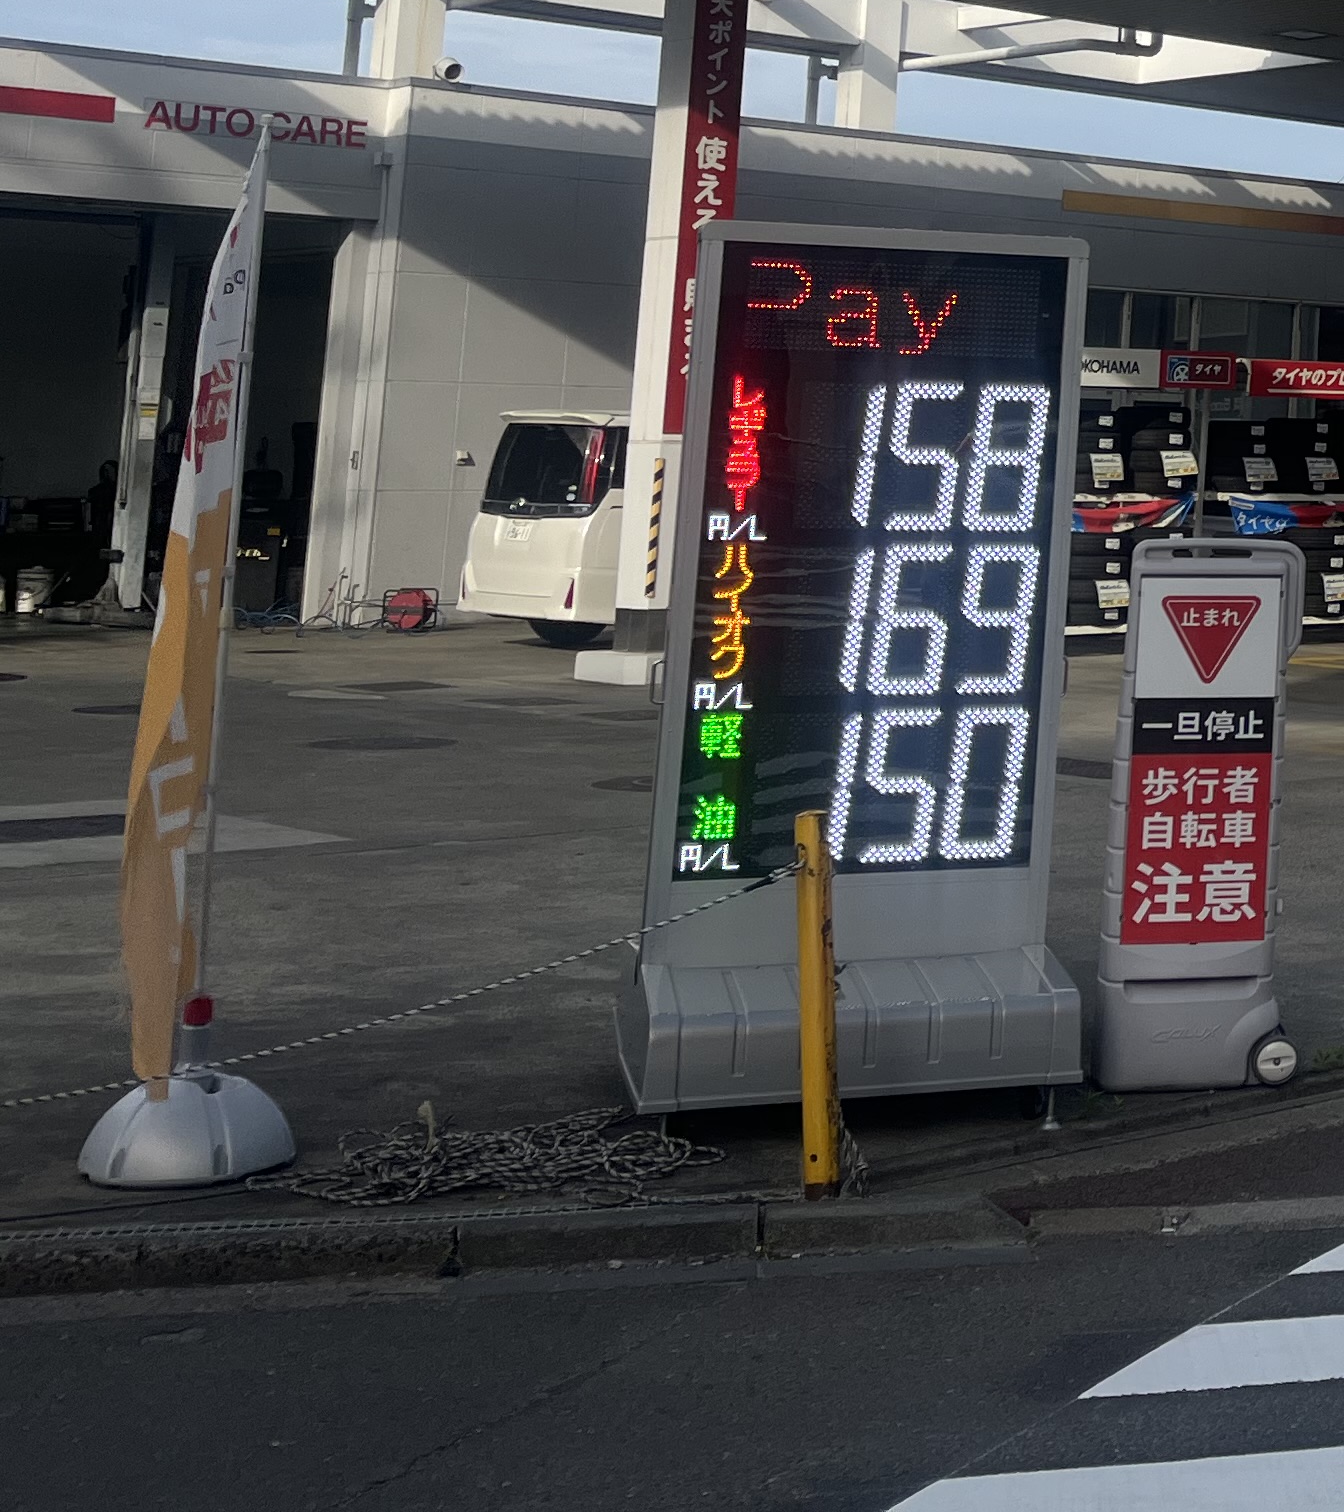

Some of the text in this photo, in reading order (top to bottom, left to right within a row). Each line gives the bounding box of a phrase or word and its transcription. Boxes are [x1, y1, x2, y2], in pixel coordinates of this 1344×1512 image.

[144, 100, 368, 149] AUTO CARE
[1195, 362, 1222, 376] タイヤ
[850, 381, 1051, 532] 158
[711, 544, 753, 680] ハイオク
[838, 542, 1041, 696] 169
[1180, 606, 1242, 629] 止まれ
[1141, 710, 1265, 742] 一旦停止
[827, 705, 1031, 865] 150
[1141, 766, 1260, 805] 歩行者
[1141, 809, 1257, 850] 自転車
[1131, 861, 1256, 923] 注意
